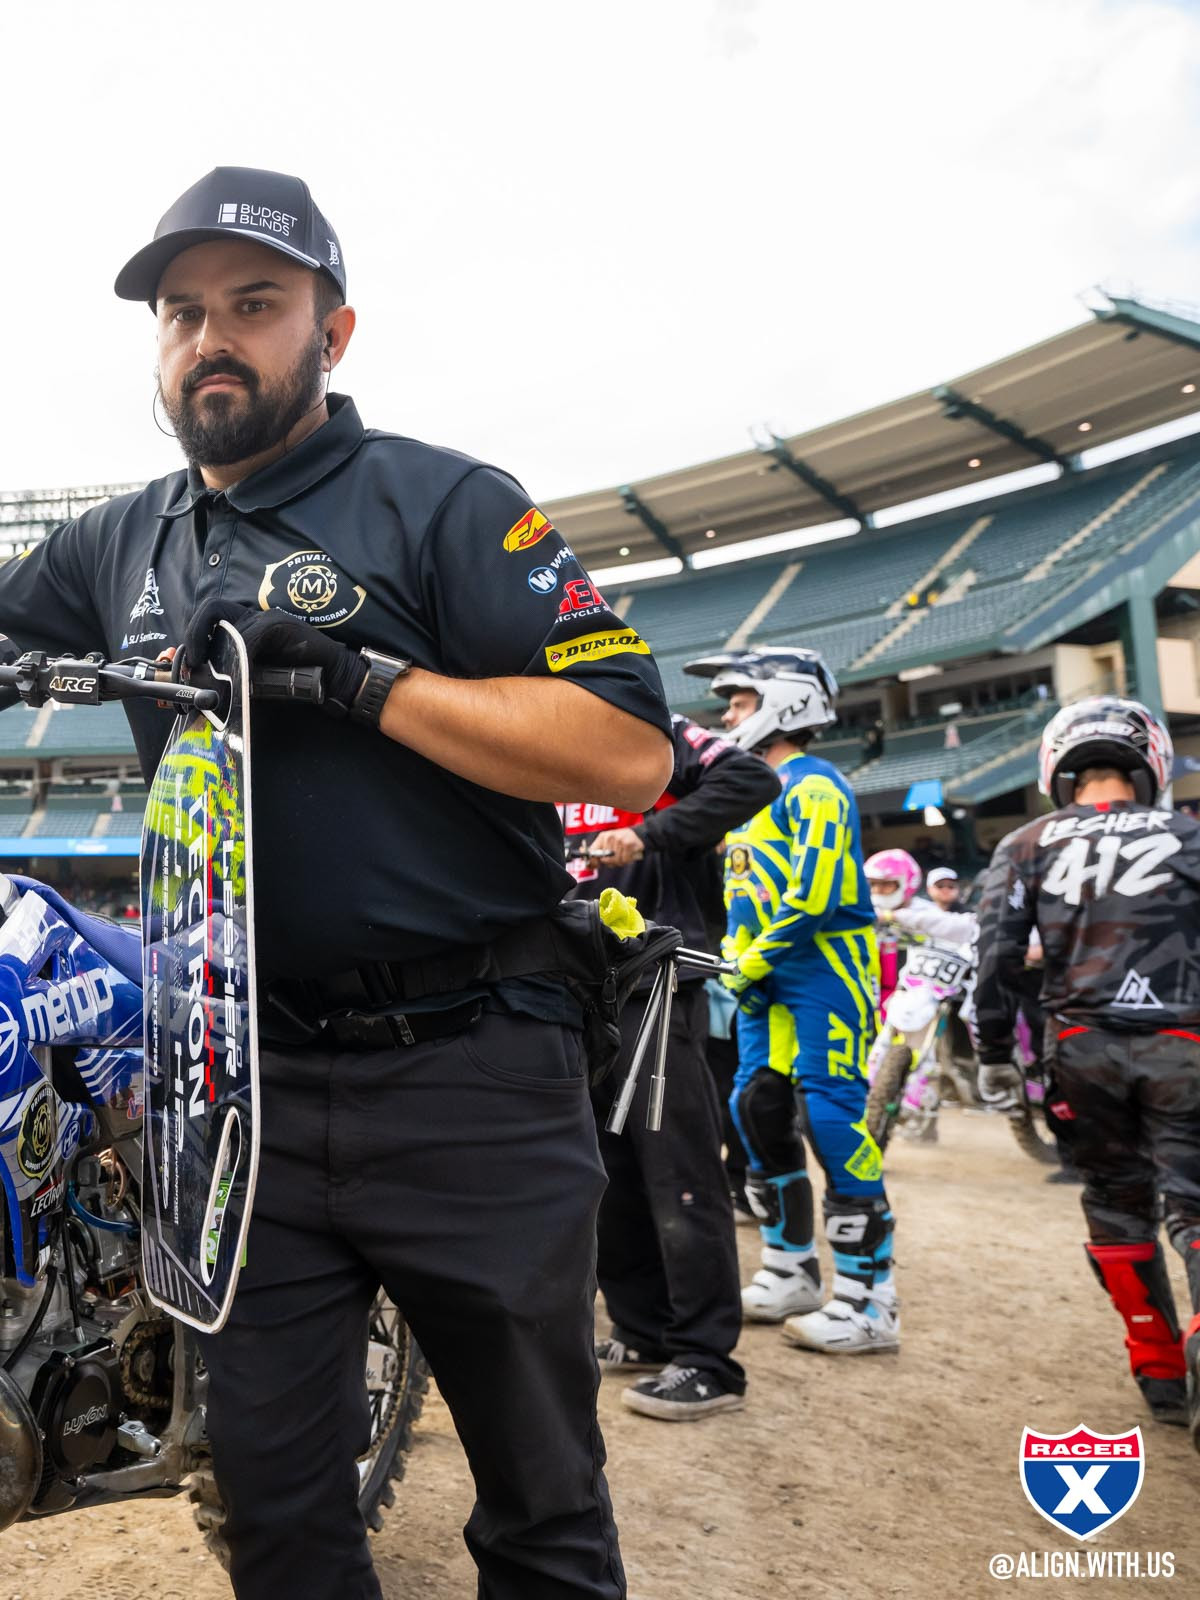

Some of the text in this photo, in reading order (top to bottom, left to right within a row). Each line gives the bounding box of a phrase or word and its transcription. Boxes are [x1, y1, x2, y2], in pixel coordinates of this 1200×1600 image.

[240, 203, 298, 228] BUDGET
[240, 213, 290, 237] BLINDS
[301, 578, 323, 594] M
[309, 607, 349, 623] PROGRAM
[49, 676, 97, 693] ARC
[176, 689, 195, 699] ARC
[777, 694, 810, 725] FLY
[1038, 810, 1173, 848] LESHER
[1041, 832, 1183, 906] 412
[188, 790, 208, 1118] LECTRON
[222, 839, 238, 1078] LESHER
[908, 955, 960, 985] 339
[827, 1011, 855, 1080] FLY
[63, 1126, 79, 1153] HP
[825, 1213, 869, 1243] G
[63, 1403, 108, 1437] LUXON
